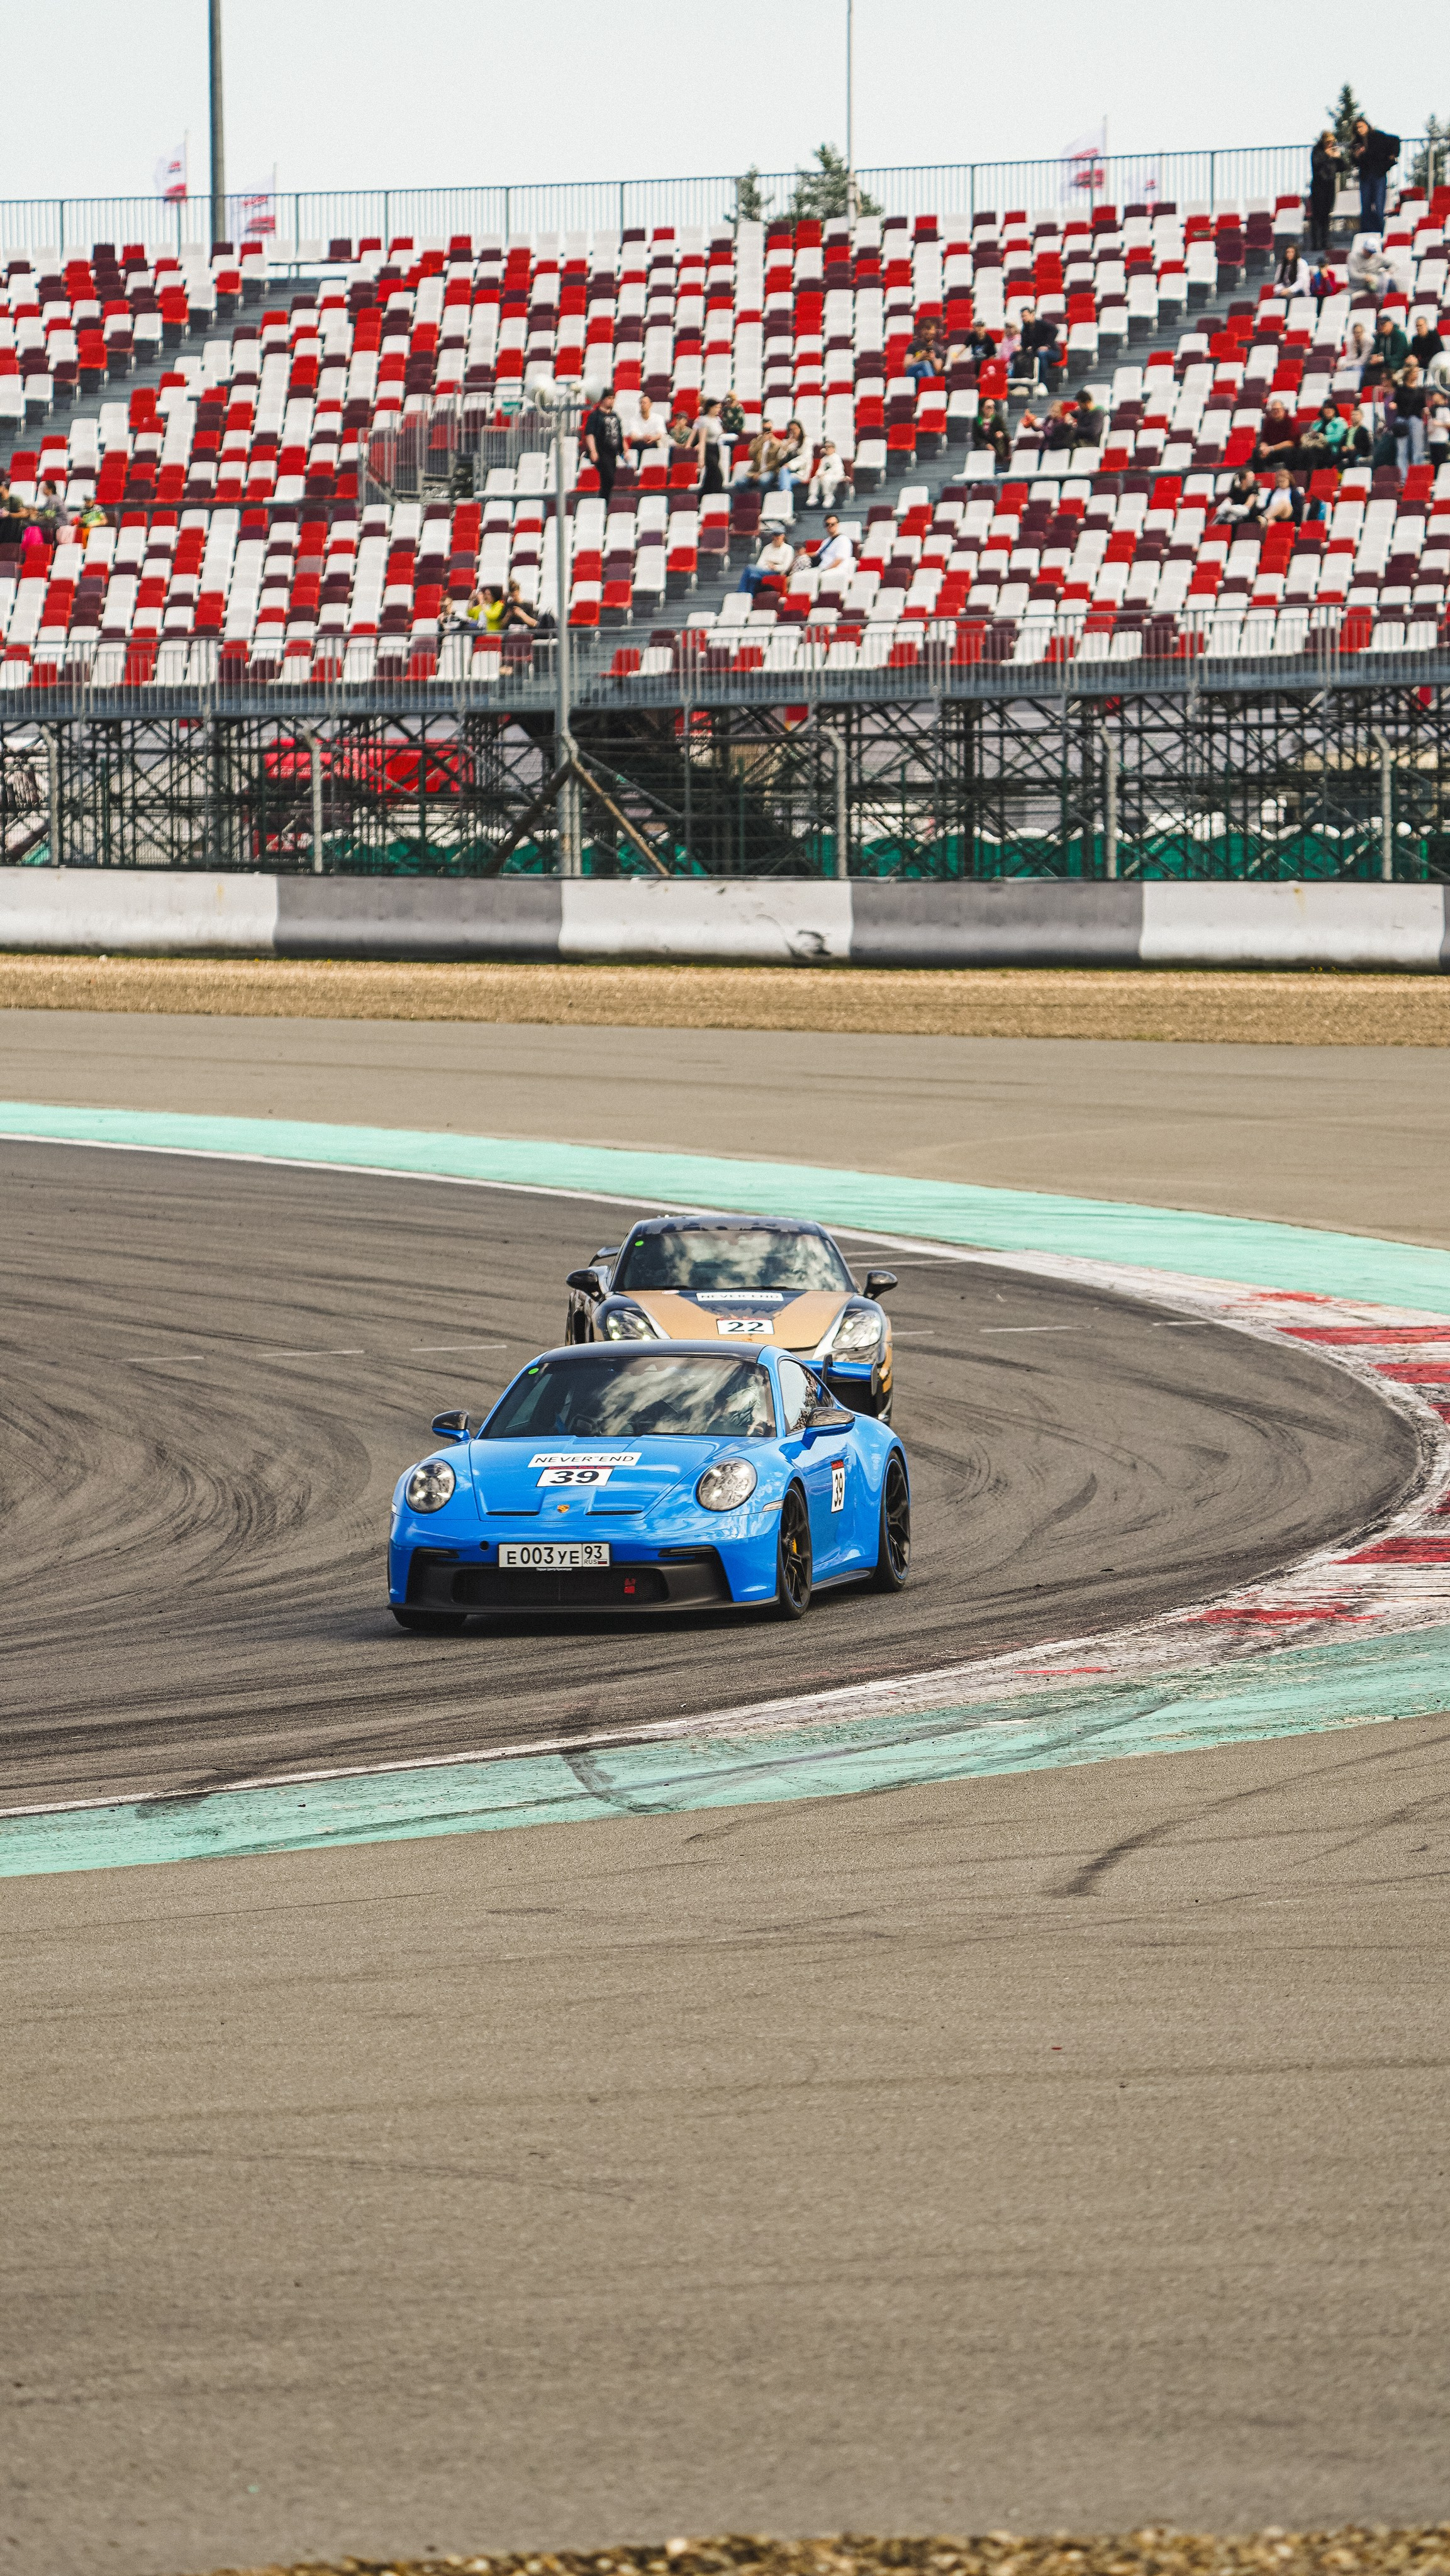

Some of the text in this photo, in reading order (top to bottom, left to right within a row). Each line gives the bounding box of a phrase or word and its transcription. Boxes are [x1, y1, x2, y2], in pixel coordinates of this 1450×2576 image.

[728, 1321, 764, 1332] 22
[549, 1470, 600, 1484] 39
[834, 1472, 844, 1507] 39
[584, 1546, 602, 1559] 93
